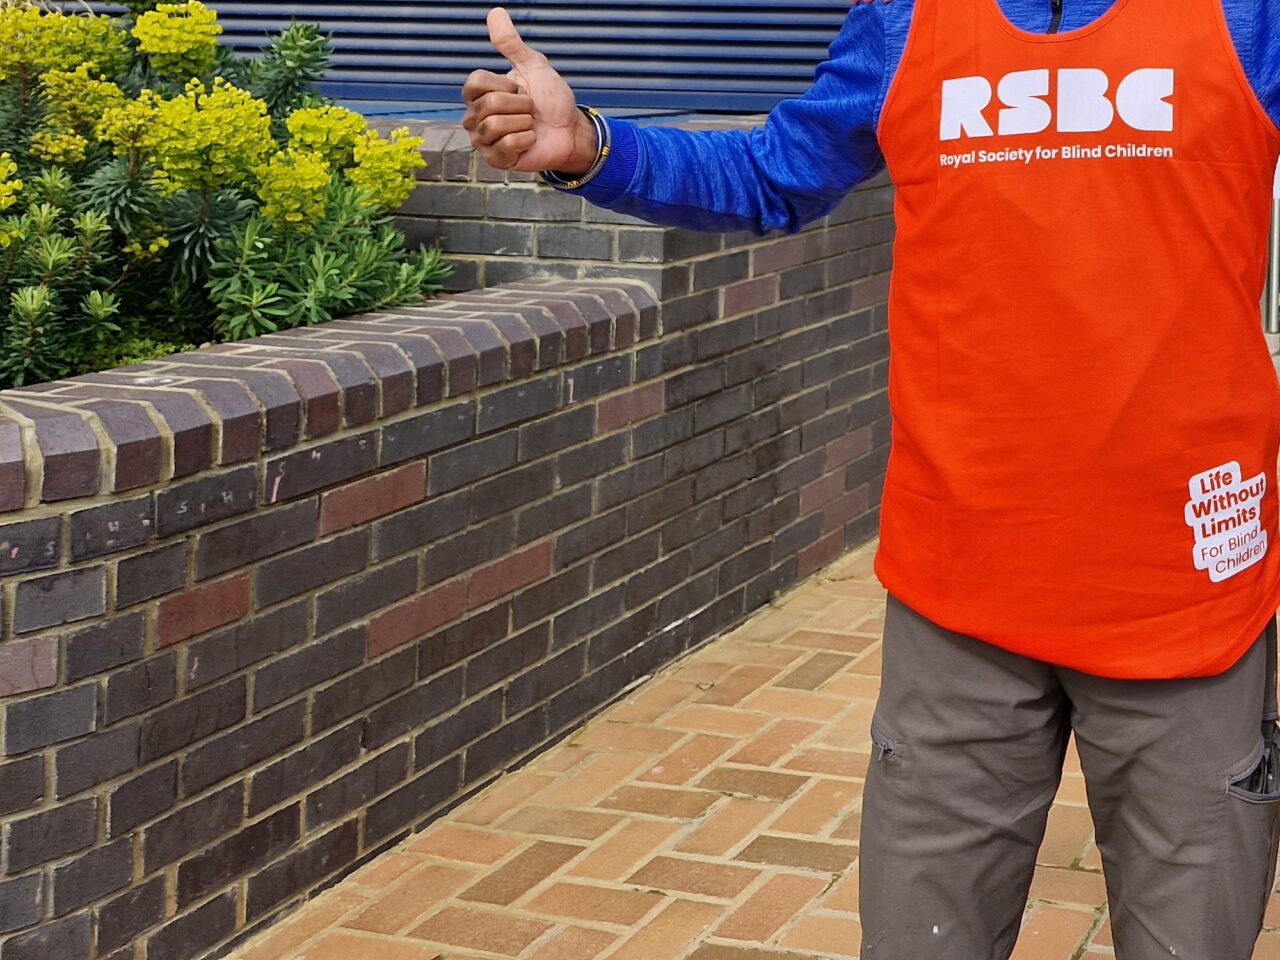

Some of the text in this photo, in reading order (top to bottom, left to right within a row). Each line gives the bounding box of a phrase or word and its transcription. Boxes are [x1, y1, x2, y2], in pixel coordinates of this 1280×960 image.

[940, 68, 1174, 141] RSBC
[940, 143, 1173, 168] Royal Society for Blind Children
[1191, 477, 1264, 519] Without
[1200, 470, 1233, 495] Life
[1201, 505, 1256, 539] Limits
[1201, 524, 1258, 561] For Blind
[1215, 539, 1265, 574] Children
